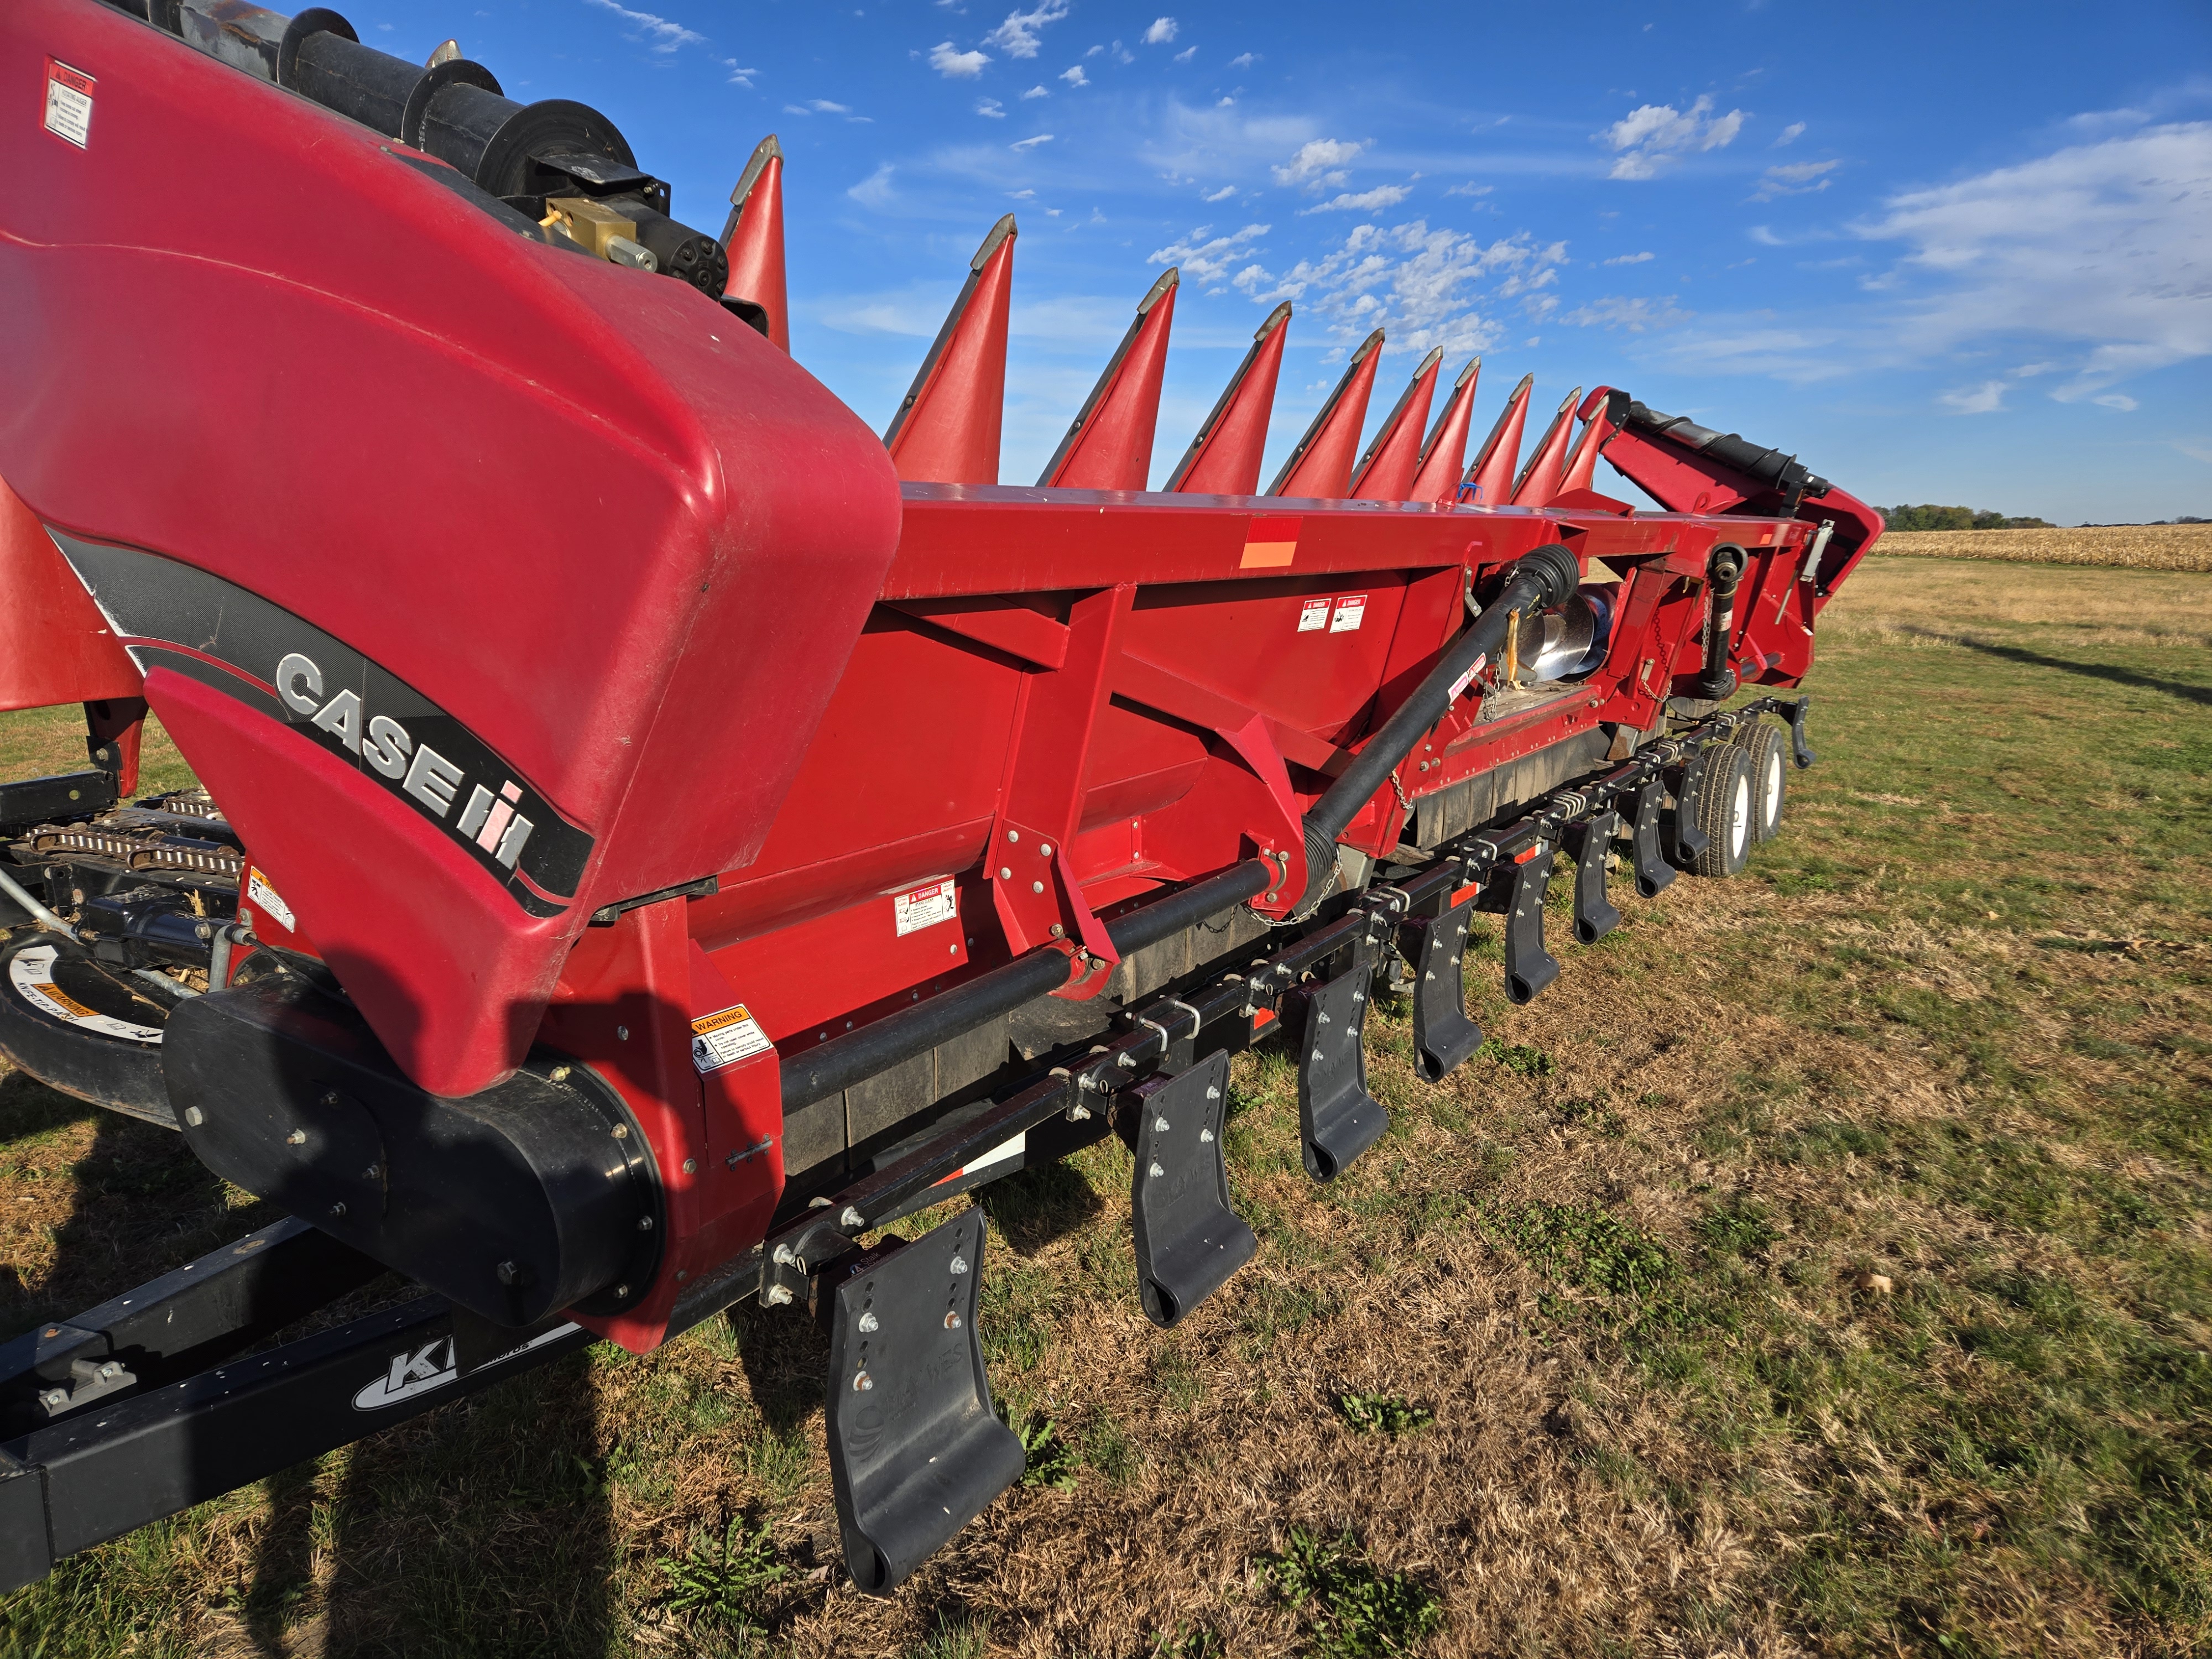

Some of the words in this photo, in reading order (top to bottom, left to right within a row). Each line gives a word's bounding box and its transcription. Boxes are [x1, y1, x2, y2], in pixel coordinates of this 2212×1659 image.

[64, 71, 86, 91] DANGER
[276, 653, 465, 818] CASE
[918, 888, 938, 899] DANGER
[48, 987, 88, 1015] WARNING
[695, 1011, 743, 1031] WARNING
[860, 1252, 881, 1265] Stalk
